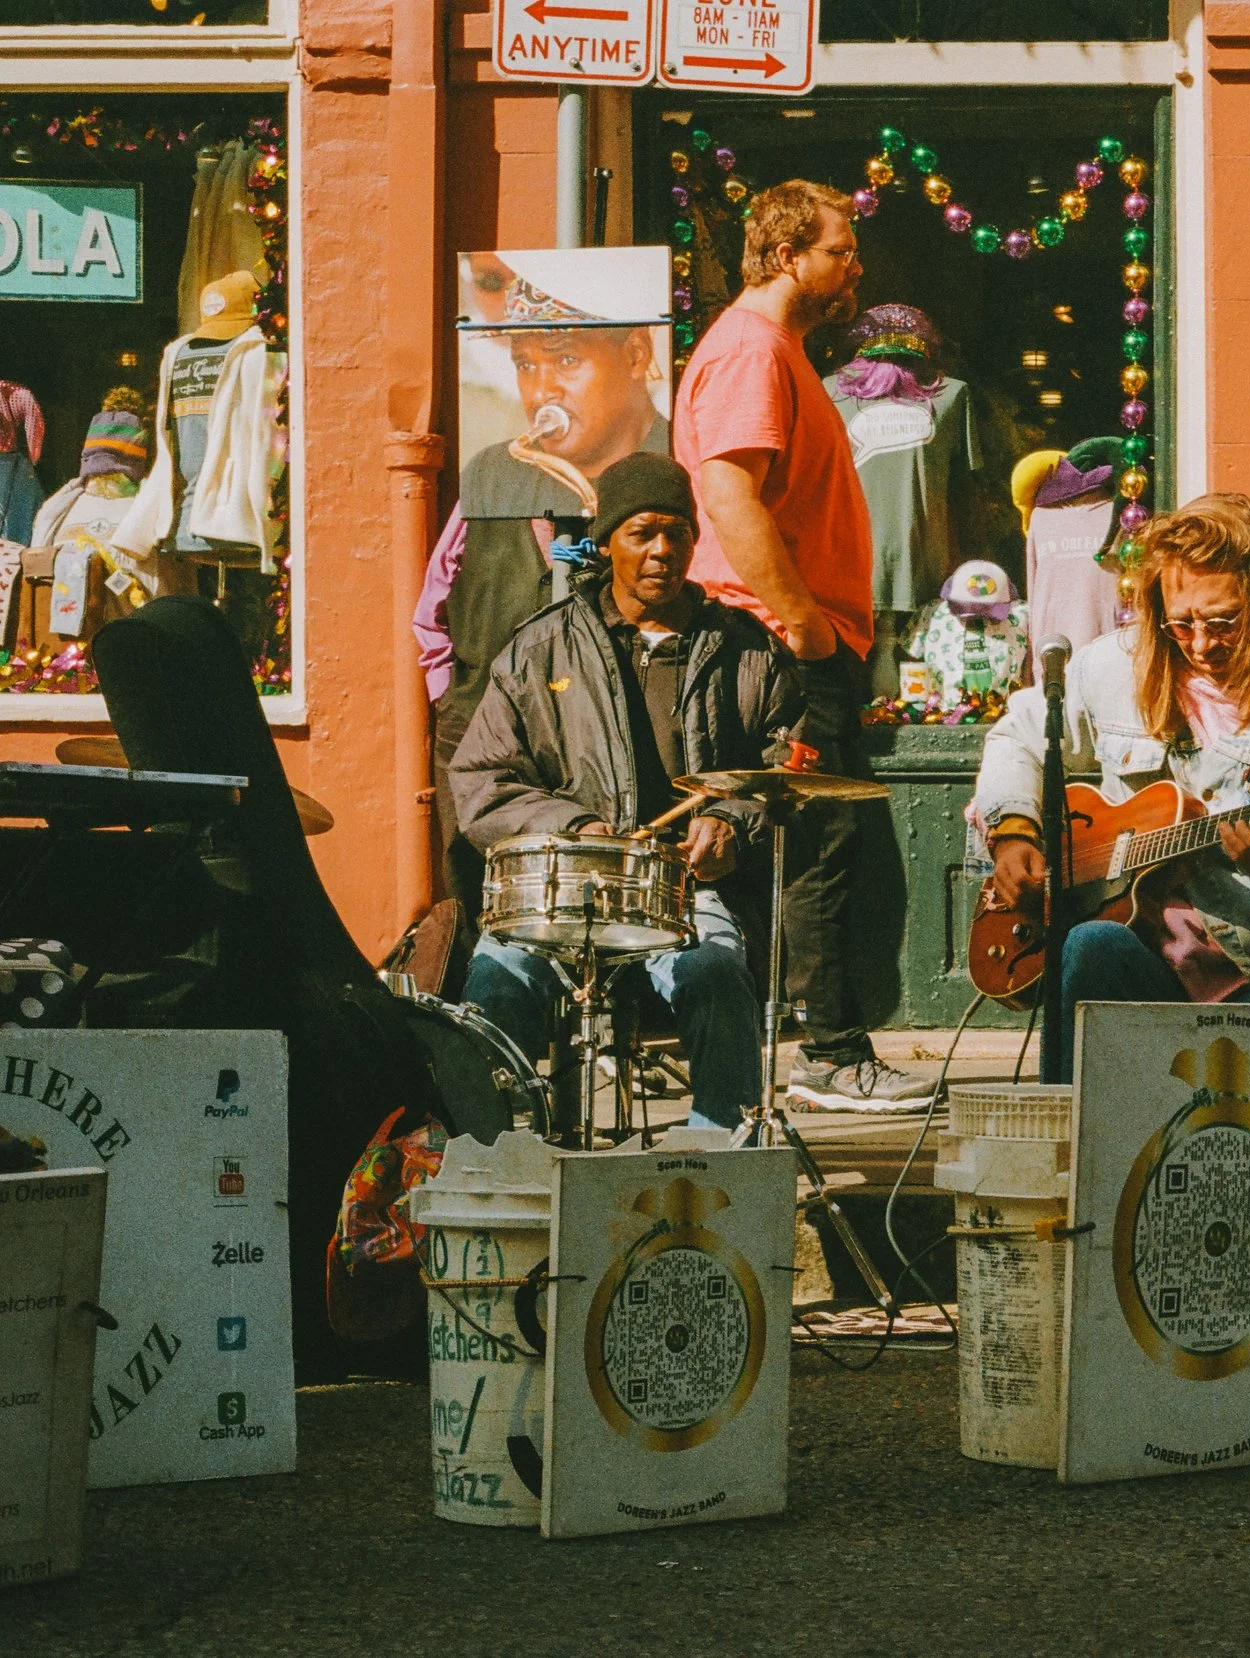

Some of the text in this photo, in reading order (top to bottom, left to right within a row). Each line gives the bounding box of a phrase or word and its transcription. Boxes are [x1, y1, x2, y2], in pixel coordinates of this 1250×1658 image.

[693, 7, 724, 25] 8AM
[747, 11, 780, 29] 11AM
[696, 28, 729, 45] MON
[752, 31, 776, 49] FRI
[508, 33, 641, 64] ANYTIME
[1196, 1014, 1224, 1028] Scan
[204, 1105, 248, 1119] PayPal
[222, 1159, 240, 1174] You
[657, 1158, 708, 1171] Scan Here
[15, 1184, 90, 1202] Orleans
[221, 1177, 243, 1192] Tube
[211, 1240, 265, 1267] Zelle
[90, 1322, 182, 1441] JAZZ
[199, 1424, 265, 1441] Cash App
[1144, 1442, 1199, 1466] DOREEN'S
[1201, 1447, 1231, 1465] JAZZ
[669, 1504, 696, 1519] JAZZ
[699, 1491, 726, 1512] BAND
